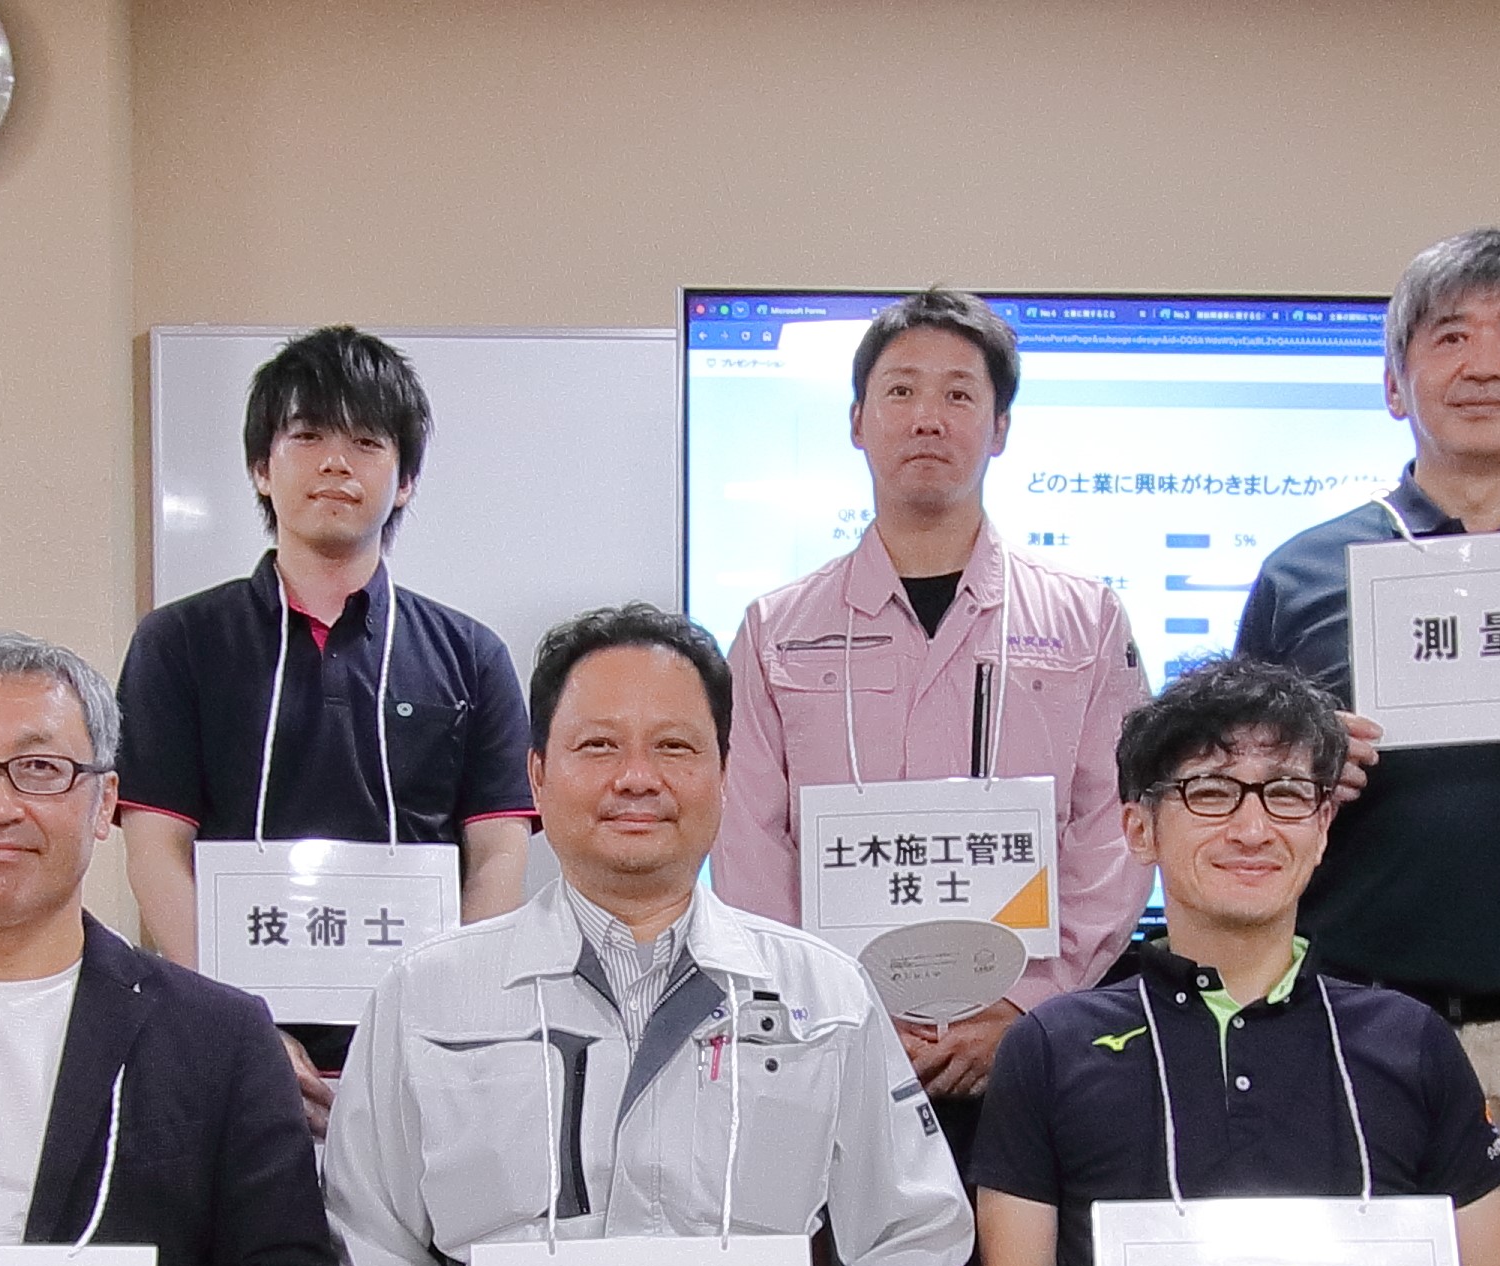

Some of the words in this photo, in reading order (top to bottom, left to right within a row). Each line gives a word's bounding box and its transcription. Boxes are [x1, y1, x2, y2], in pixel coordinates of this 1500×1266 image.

[1026, 472, 1386, 496] どの士業に興味がわきましたか?
[837, 508, 856, 522] QR
[1027, 532, 1071, 547] 測量士
[1234, 533, 1257, 548] 5%
[1094, 575, 1129, 590] 査士
[823, 831, 1036, 870] 土木施工管理
[888, 871, 971, 906] 技士
[247, 905, 405, 947] 技術士
